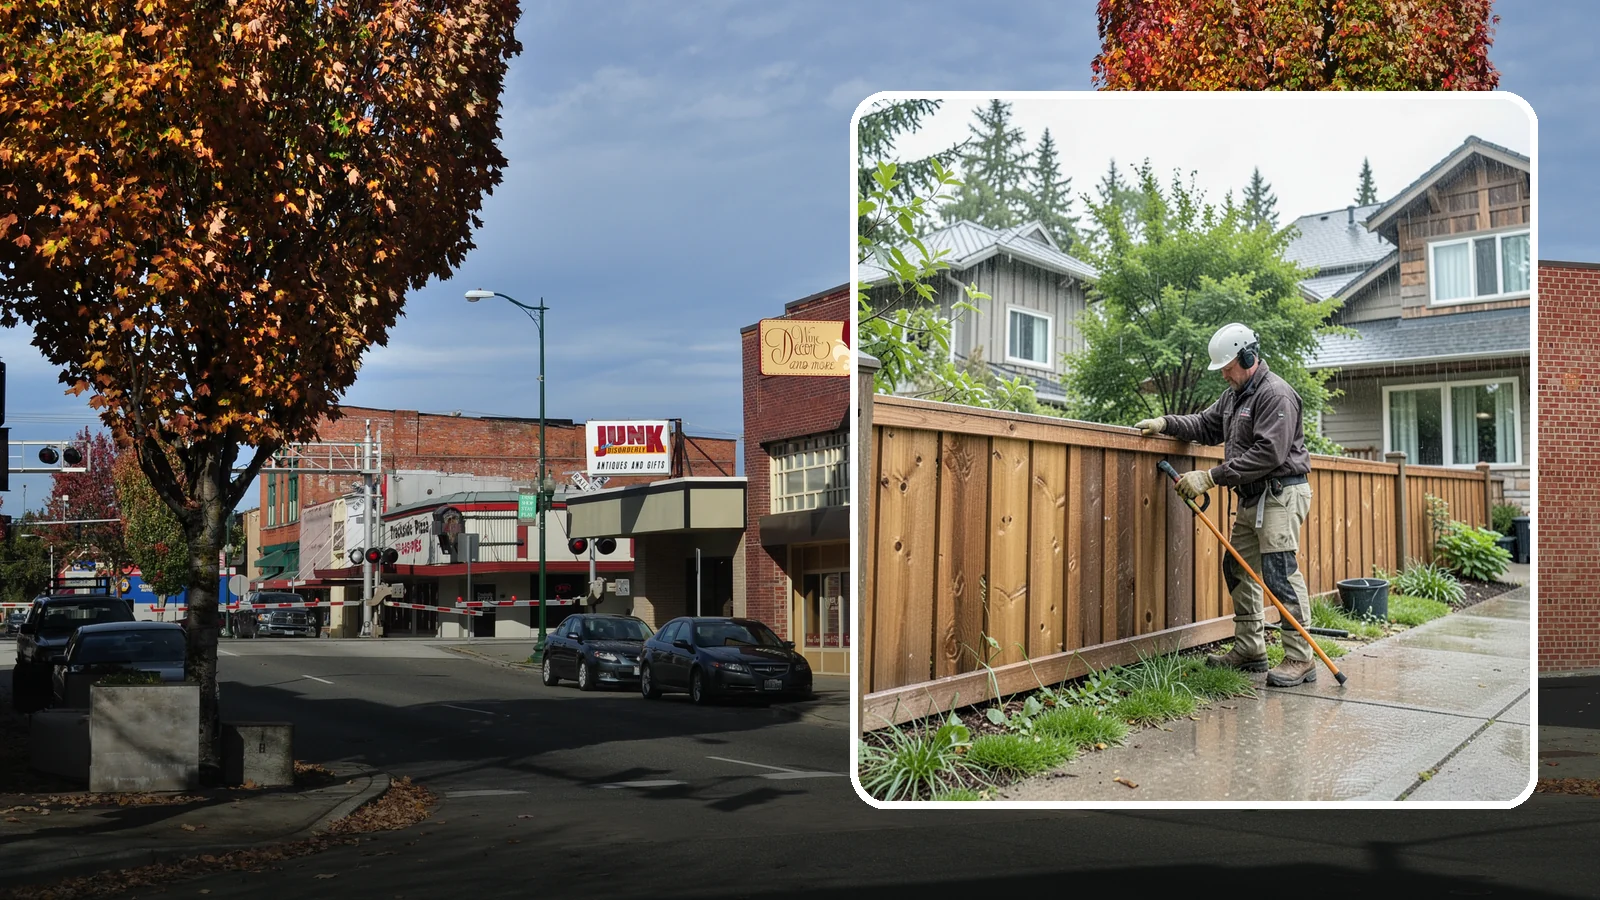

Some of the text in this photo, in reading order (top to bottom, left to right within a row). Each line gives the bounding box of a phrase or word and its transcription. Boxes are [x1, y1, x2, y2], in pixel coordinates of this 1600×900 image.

[791, 325, 823, 345] Wine
[765, 328, 830, 365] Decor
[595, 425, 665, 457] JUNK
[607, 446, 645, 454] DISORDERLY
[597, 461, 665, 469] ANTIQUES AND GIFTS
[352, 498, 365, 511] CRO
[390, 519, 429, 540] Trackside Pizza
